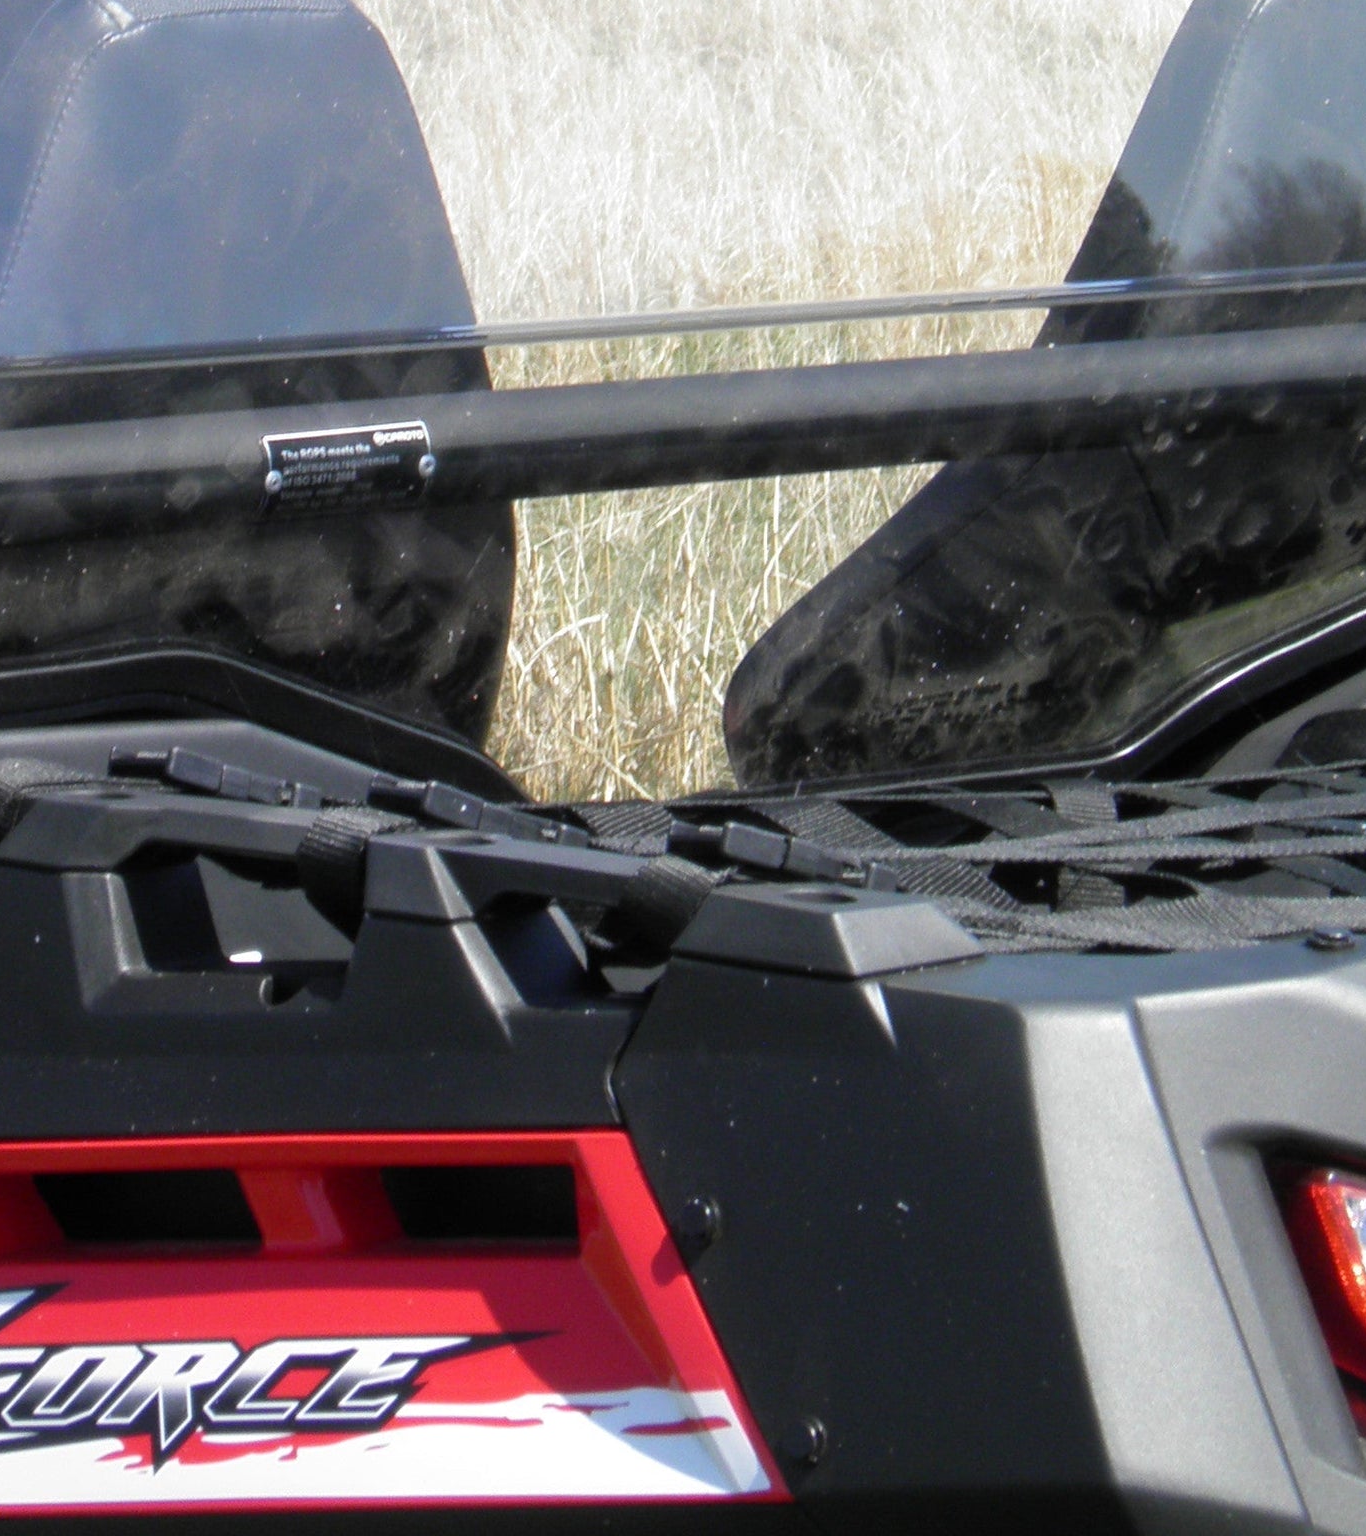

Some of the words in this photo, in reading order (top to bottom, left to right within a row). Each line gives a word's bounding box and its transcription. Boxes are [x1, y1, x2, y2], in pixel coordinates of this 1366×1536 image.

[281, 449, 299, 461] The
[300, 446, 326, 459] ROPS
[327, 445, 354, 457] meets
[355, 443, 371, 456] the
